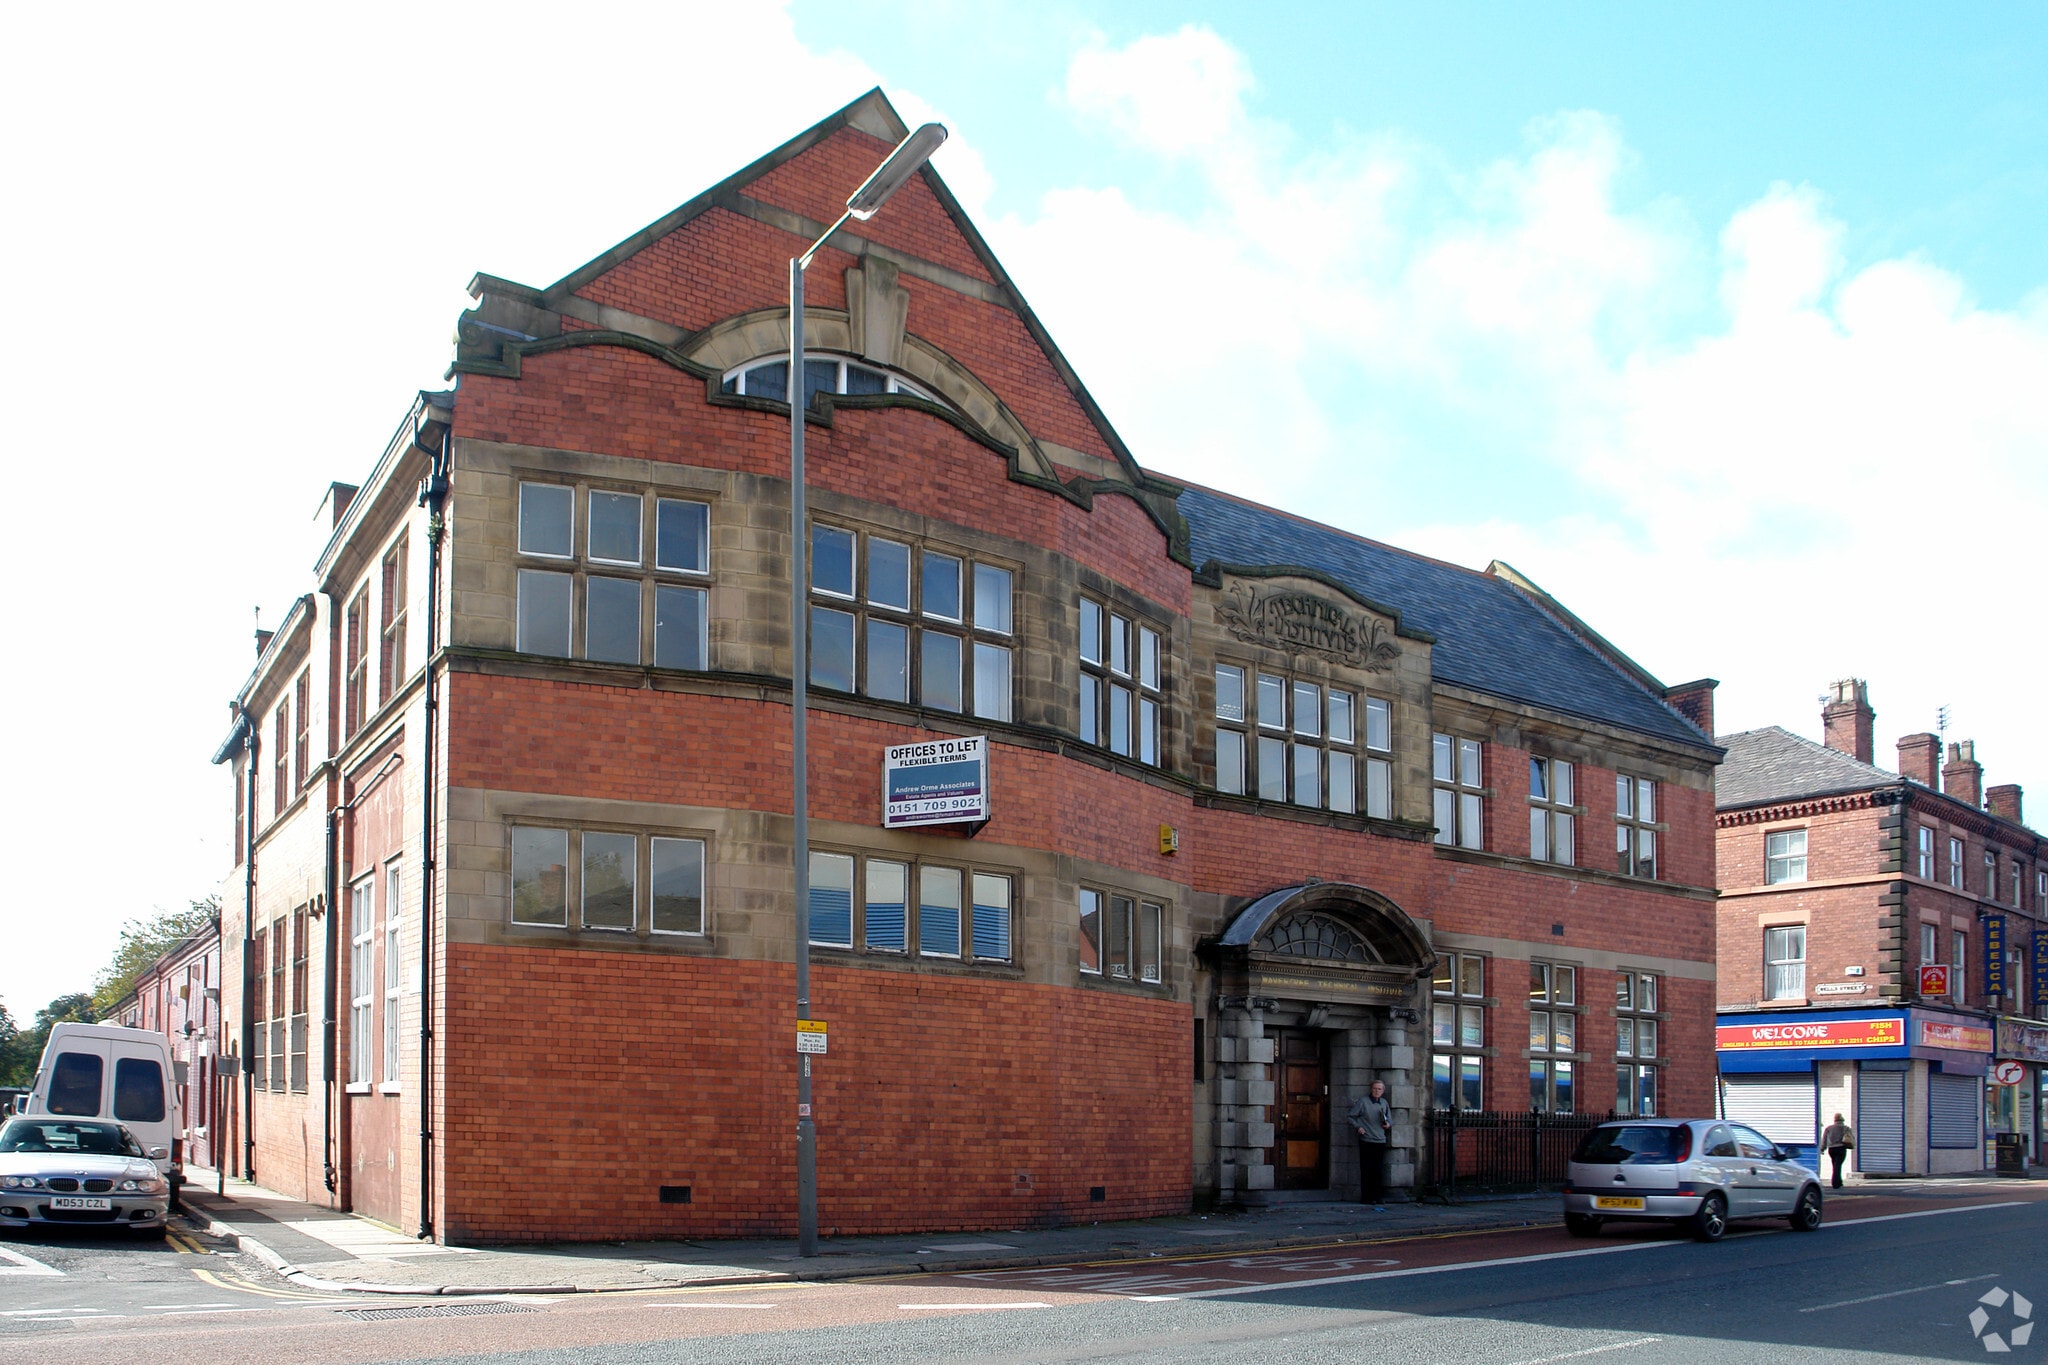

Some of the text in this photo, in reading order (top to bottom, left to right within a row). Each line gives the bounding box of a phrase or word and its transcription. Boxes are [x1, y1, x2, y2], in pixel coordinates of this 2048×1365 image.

[1270, 598, 1354, 635] TECHNICAL
[891, 739, 978, 760] OFFICES TO LET
[900, 753, 967, 767] FLEXIBLE TERMS
[940, 781, 975, 789] Associates
[889, 797, 981, 814] 0151 709 9021
[1989, 921, 2001, 991] REBECCA
[1752, 1026, 1828, 1040] WELCOME
[56, 1198, 106, 1208] MD53 CZL
[952, 1267, 1268, 1296] LANE
